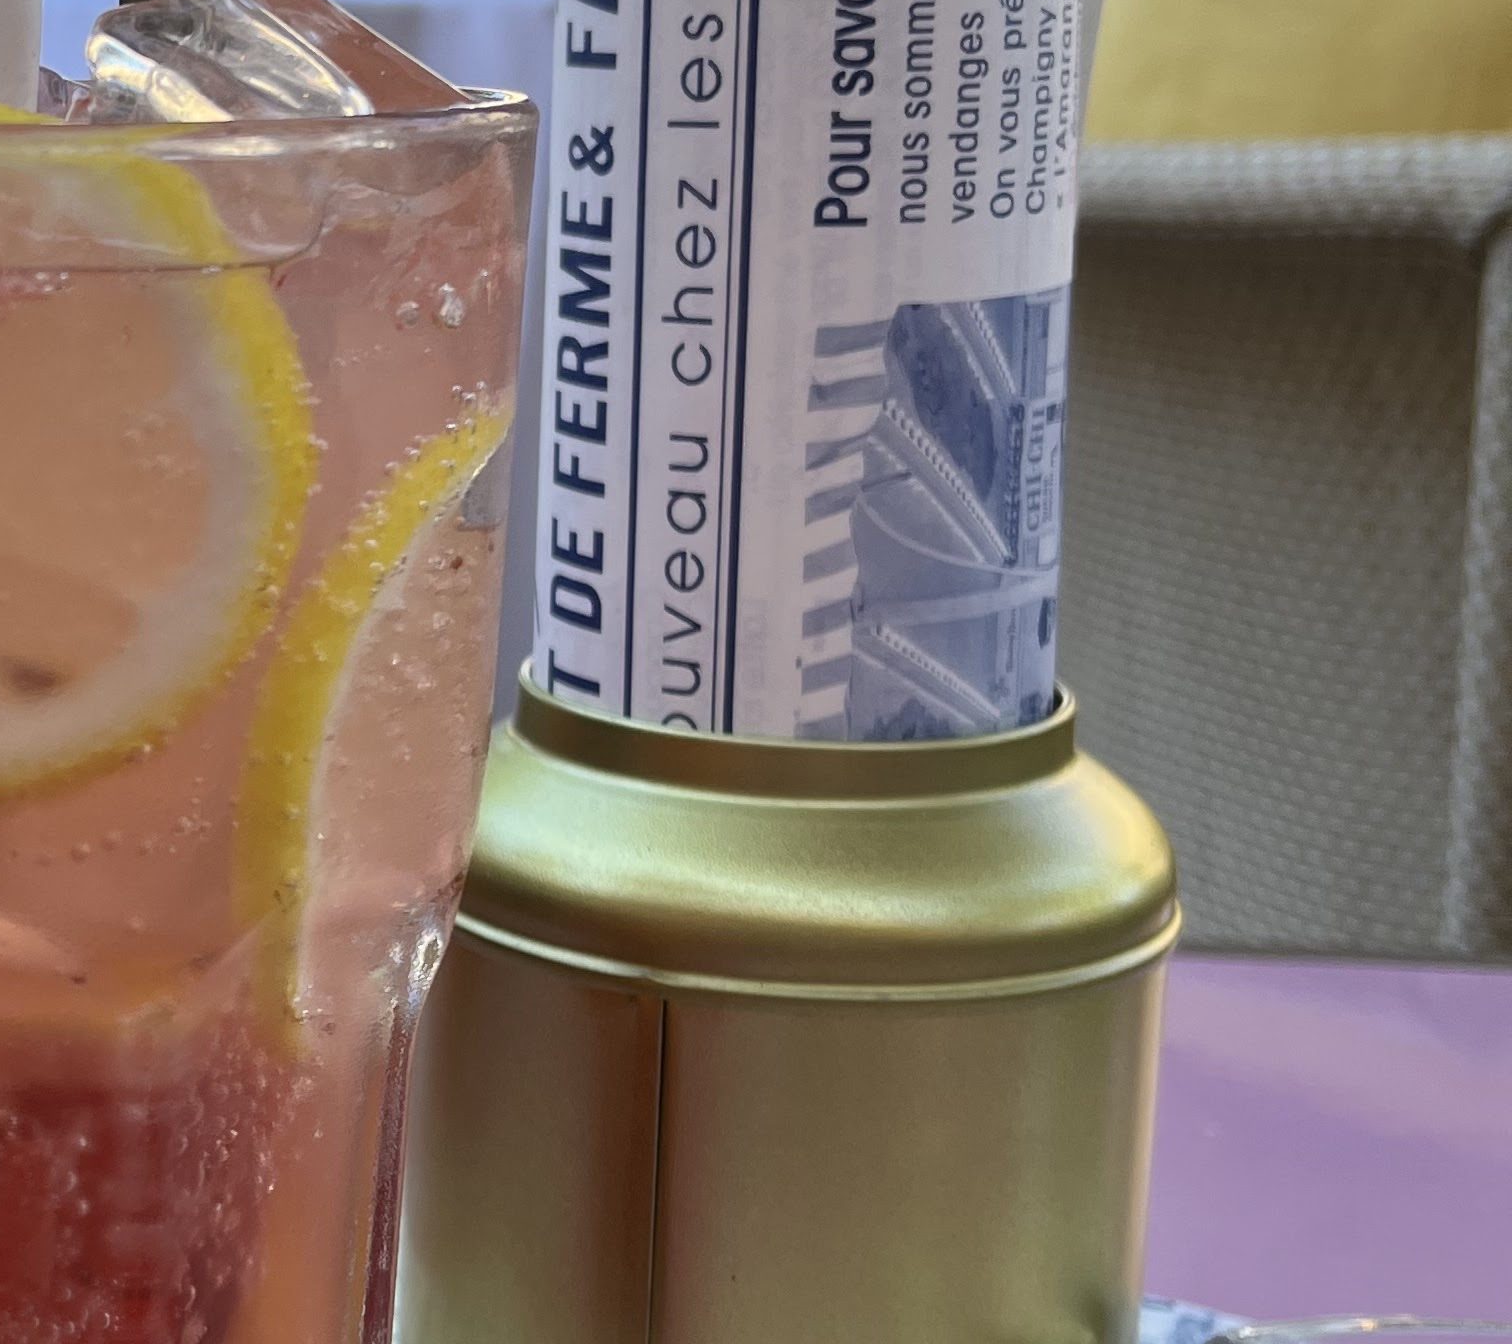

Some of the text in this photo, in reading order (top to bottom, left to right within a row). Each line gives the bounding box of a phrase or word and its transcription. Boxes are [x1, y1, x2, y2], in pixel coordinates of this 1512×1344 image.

[667, 11, 724, 128] les
[948, 10, 989, 224] vendanges
[997, 65, 1022, 154] vous
[1024, 5, 1058, 215] Champigny
[813, 110, 872, 227] Pour
[898, 130, 931, 224] nous
[989, 167, 1017, 219] On
[660, 177, 719, 386] chez
[551, 189, 613, 499] FERME
[548, 515, 605, 633] DE
[547, 646, 601, 697] T
